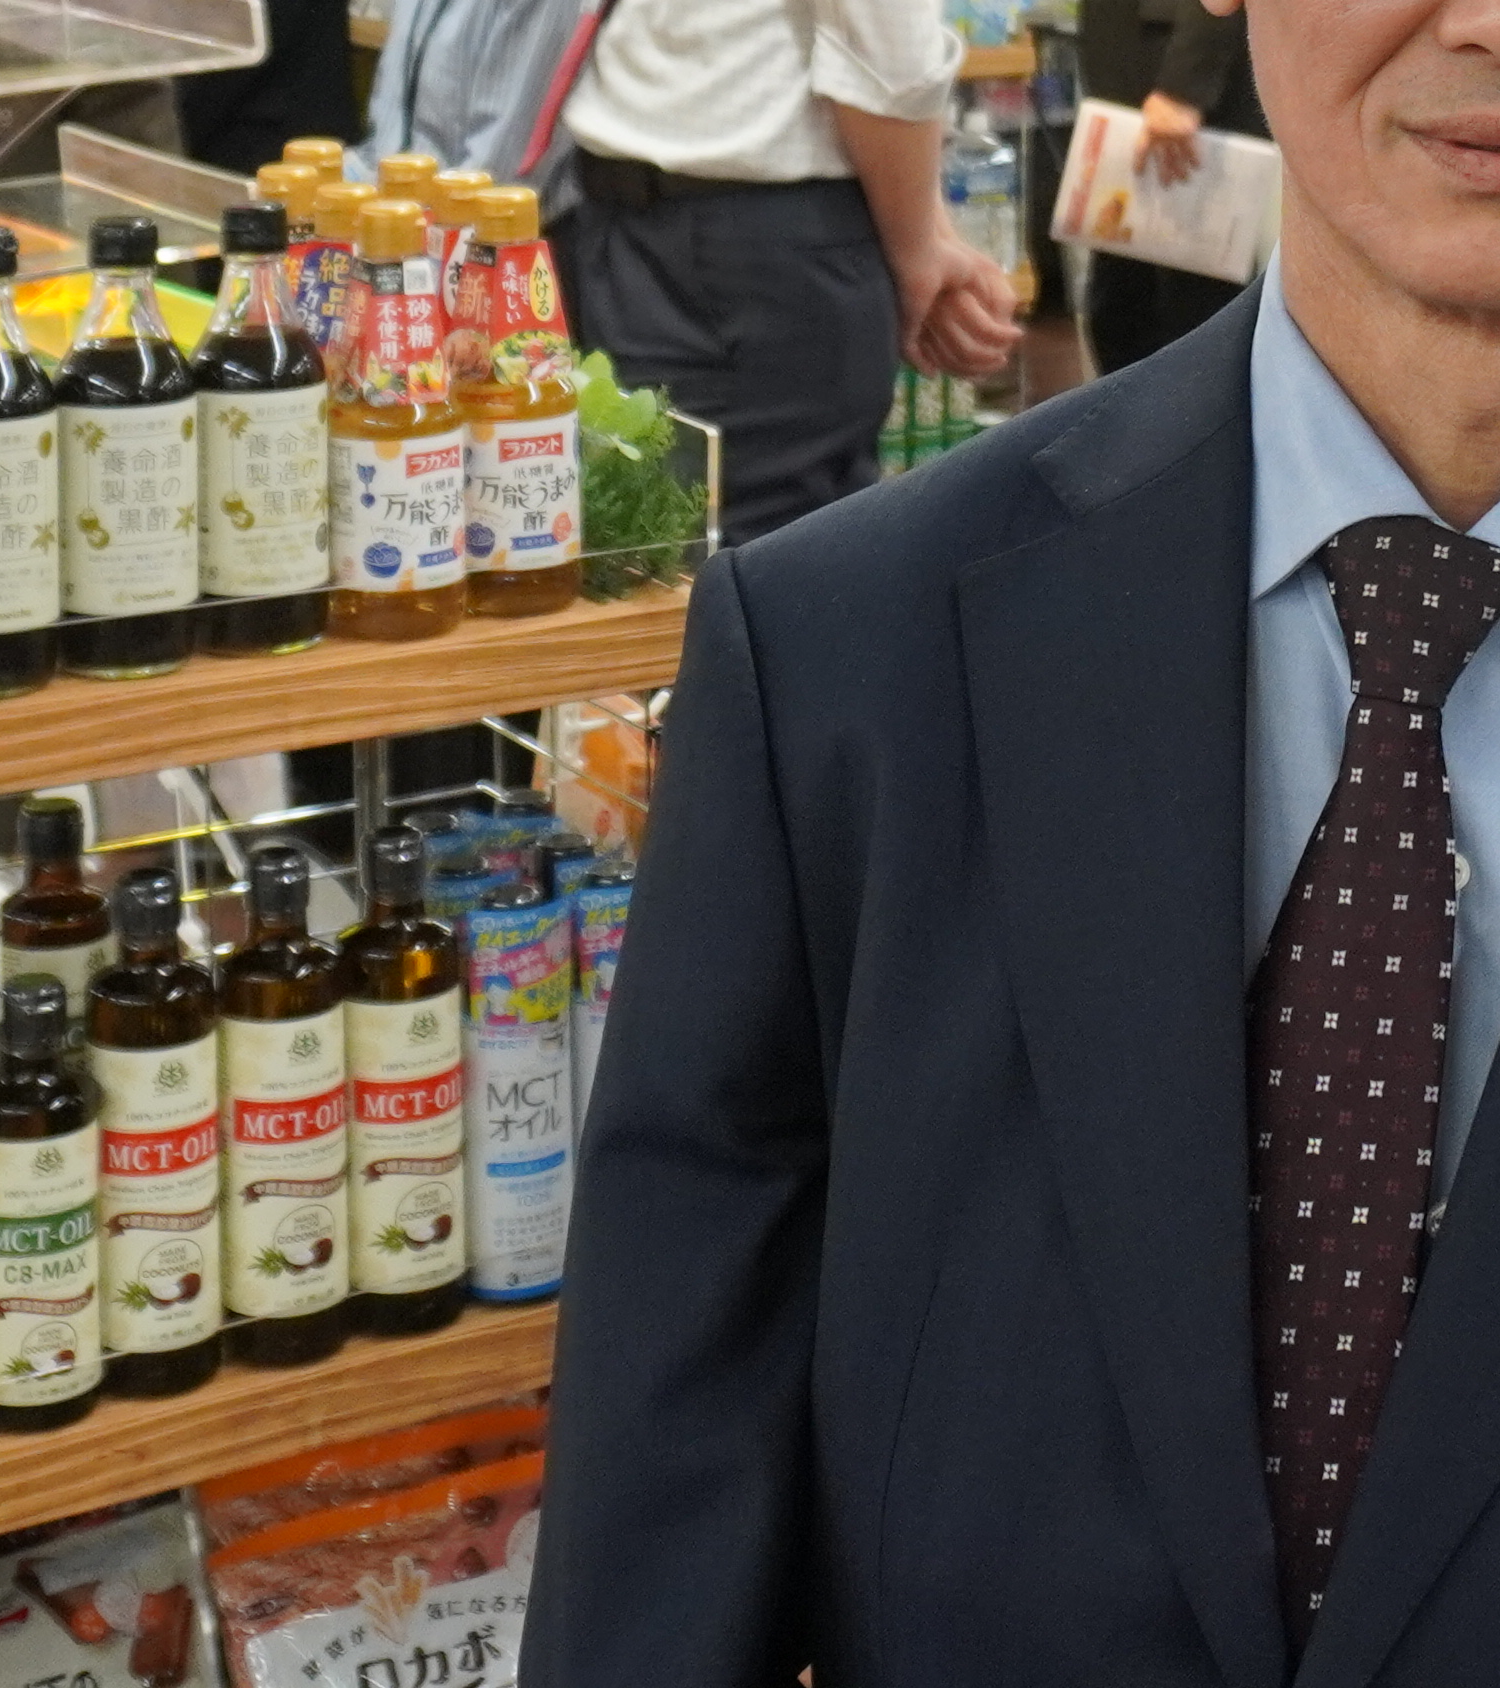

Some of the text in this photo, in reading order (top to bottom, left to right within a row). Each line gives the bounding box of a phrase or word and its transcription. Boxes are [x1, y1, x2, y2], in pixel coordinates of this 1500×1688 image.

[533, 267, 550, 317] かける
[376, 300, 399, 360] 不使用
[405, 297, 435, 349] 砂糖
[503, 435, 563, 458] ラカント
[485, 1069, 564, 1113] MCT
[489, 1107, 563, 1142] オイル
[3, 1254, 88, 1285] C8-MAX
